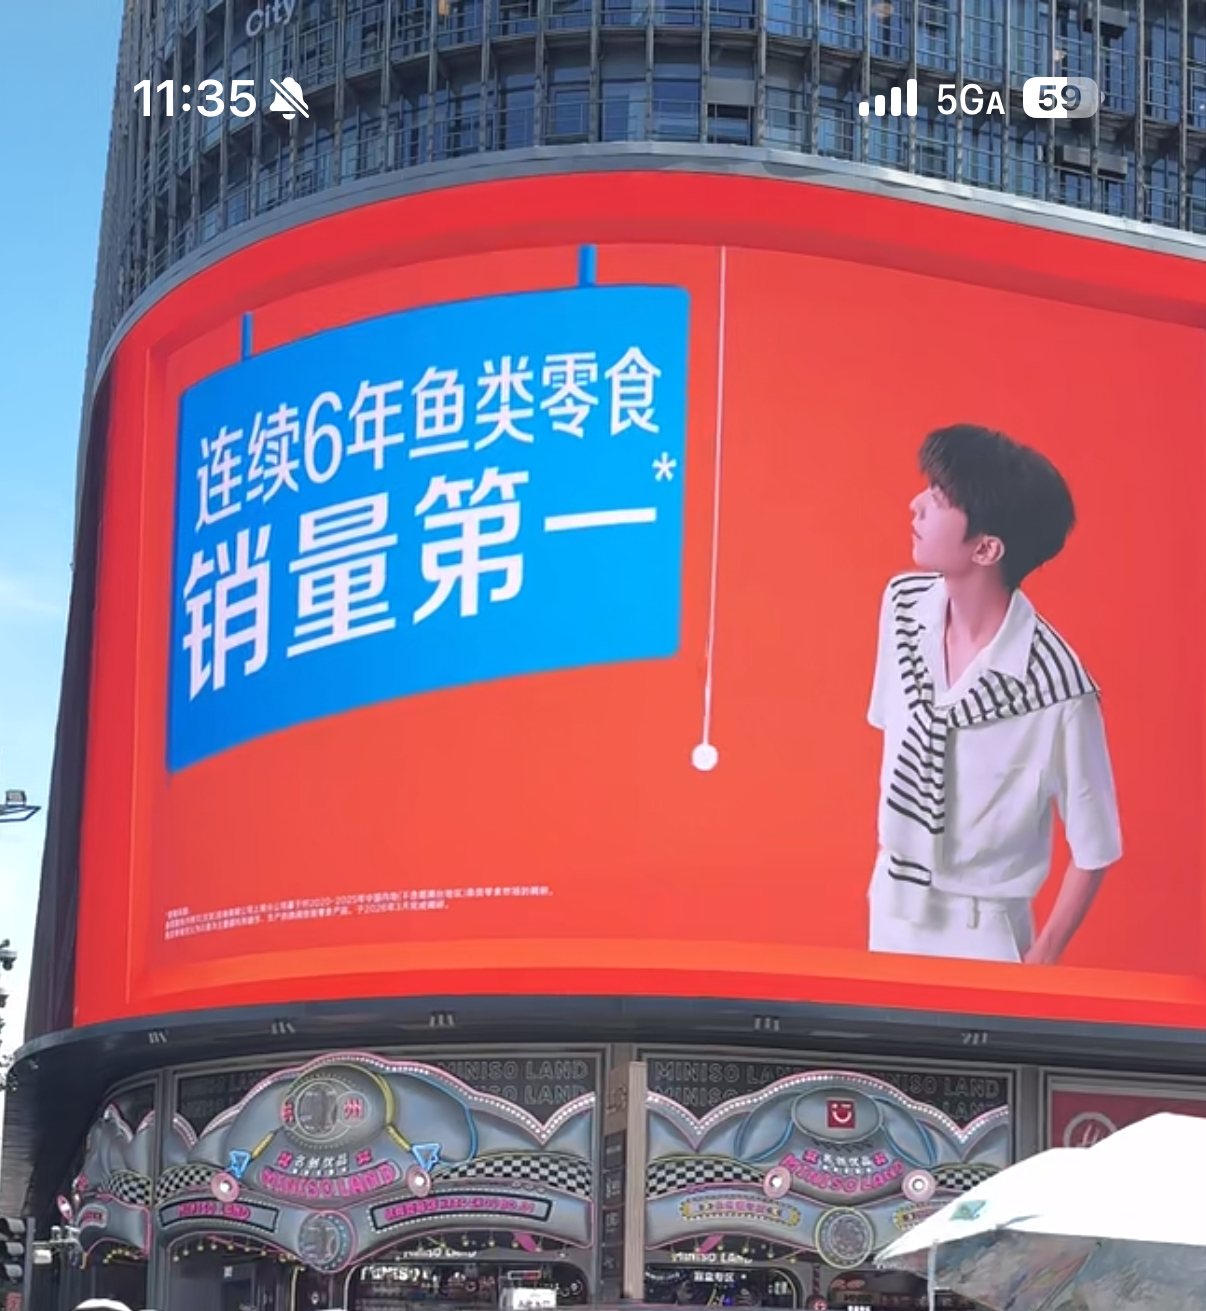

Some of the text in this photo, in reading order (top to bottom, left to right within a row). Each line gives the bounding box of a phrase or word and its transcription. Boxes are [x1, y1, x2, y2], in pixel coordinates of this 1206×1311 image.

[246, 0, 295, 37] City
[195, 347, 661, 533] 连续6年鱼类零食
[526, 1061, 588, 1080] LAND
[655, 1061, 739, 1082] MINISO
[944, 1077, 999, 1098] LAND
